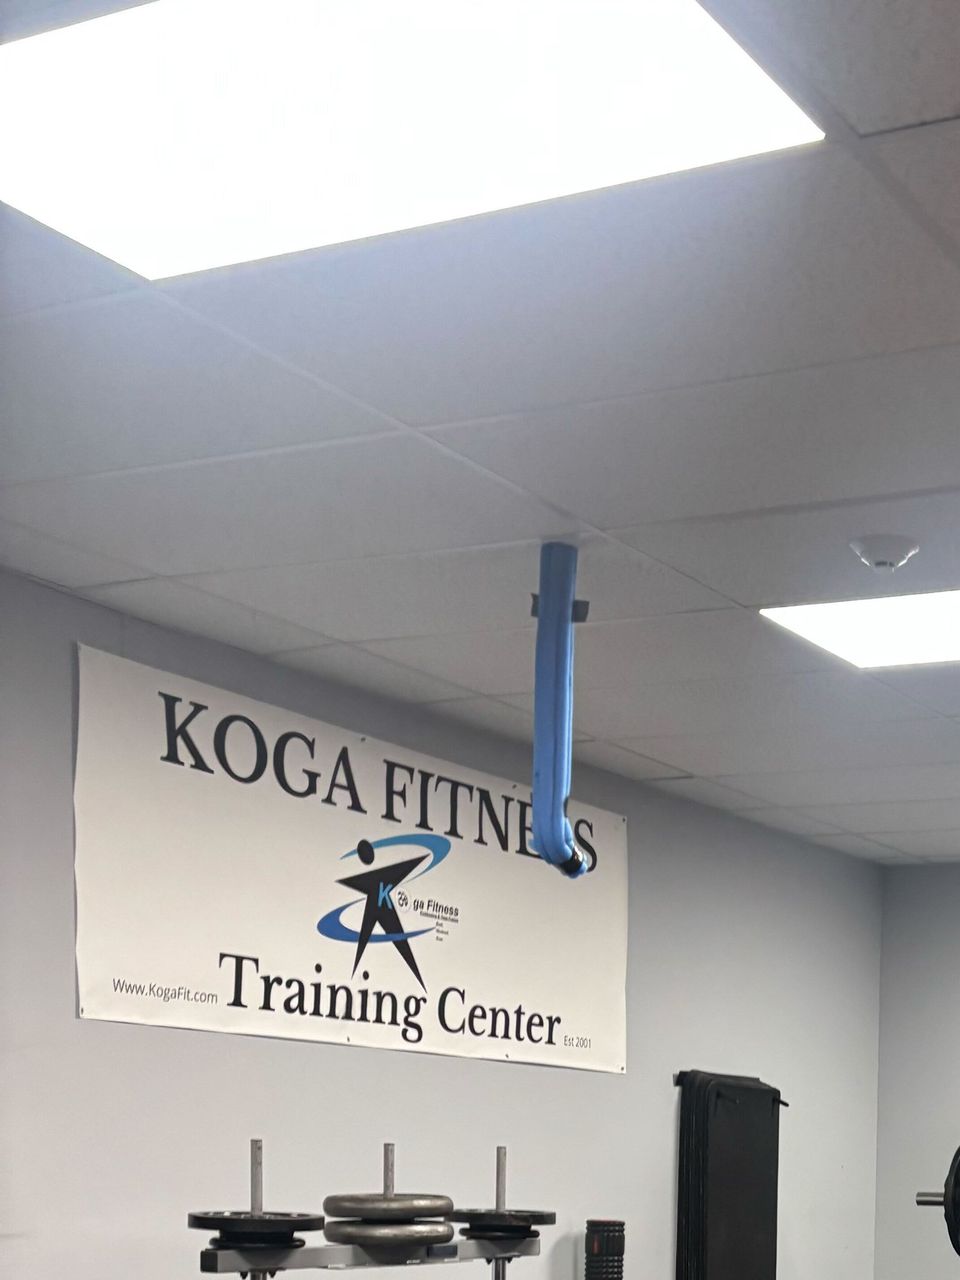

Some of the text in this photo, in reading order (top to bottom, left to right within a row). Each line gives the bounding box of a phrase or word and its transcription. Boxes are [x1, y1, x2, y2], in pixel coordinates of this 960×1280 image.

[158, 691, 597, 872] KOGA FITNES
[427, 899, 459, 917] Fitness
[112, 977, 218, 1005] Www.KogaFit.com
[218, 952, 561, 1046] Training Center
[563, 1035, 592, 1049] Est 2001
